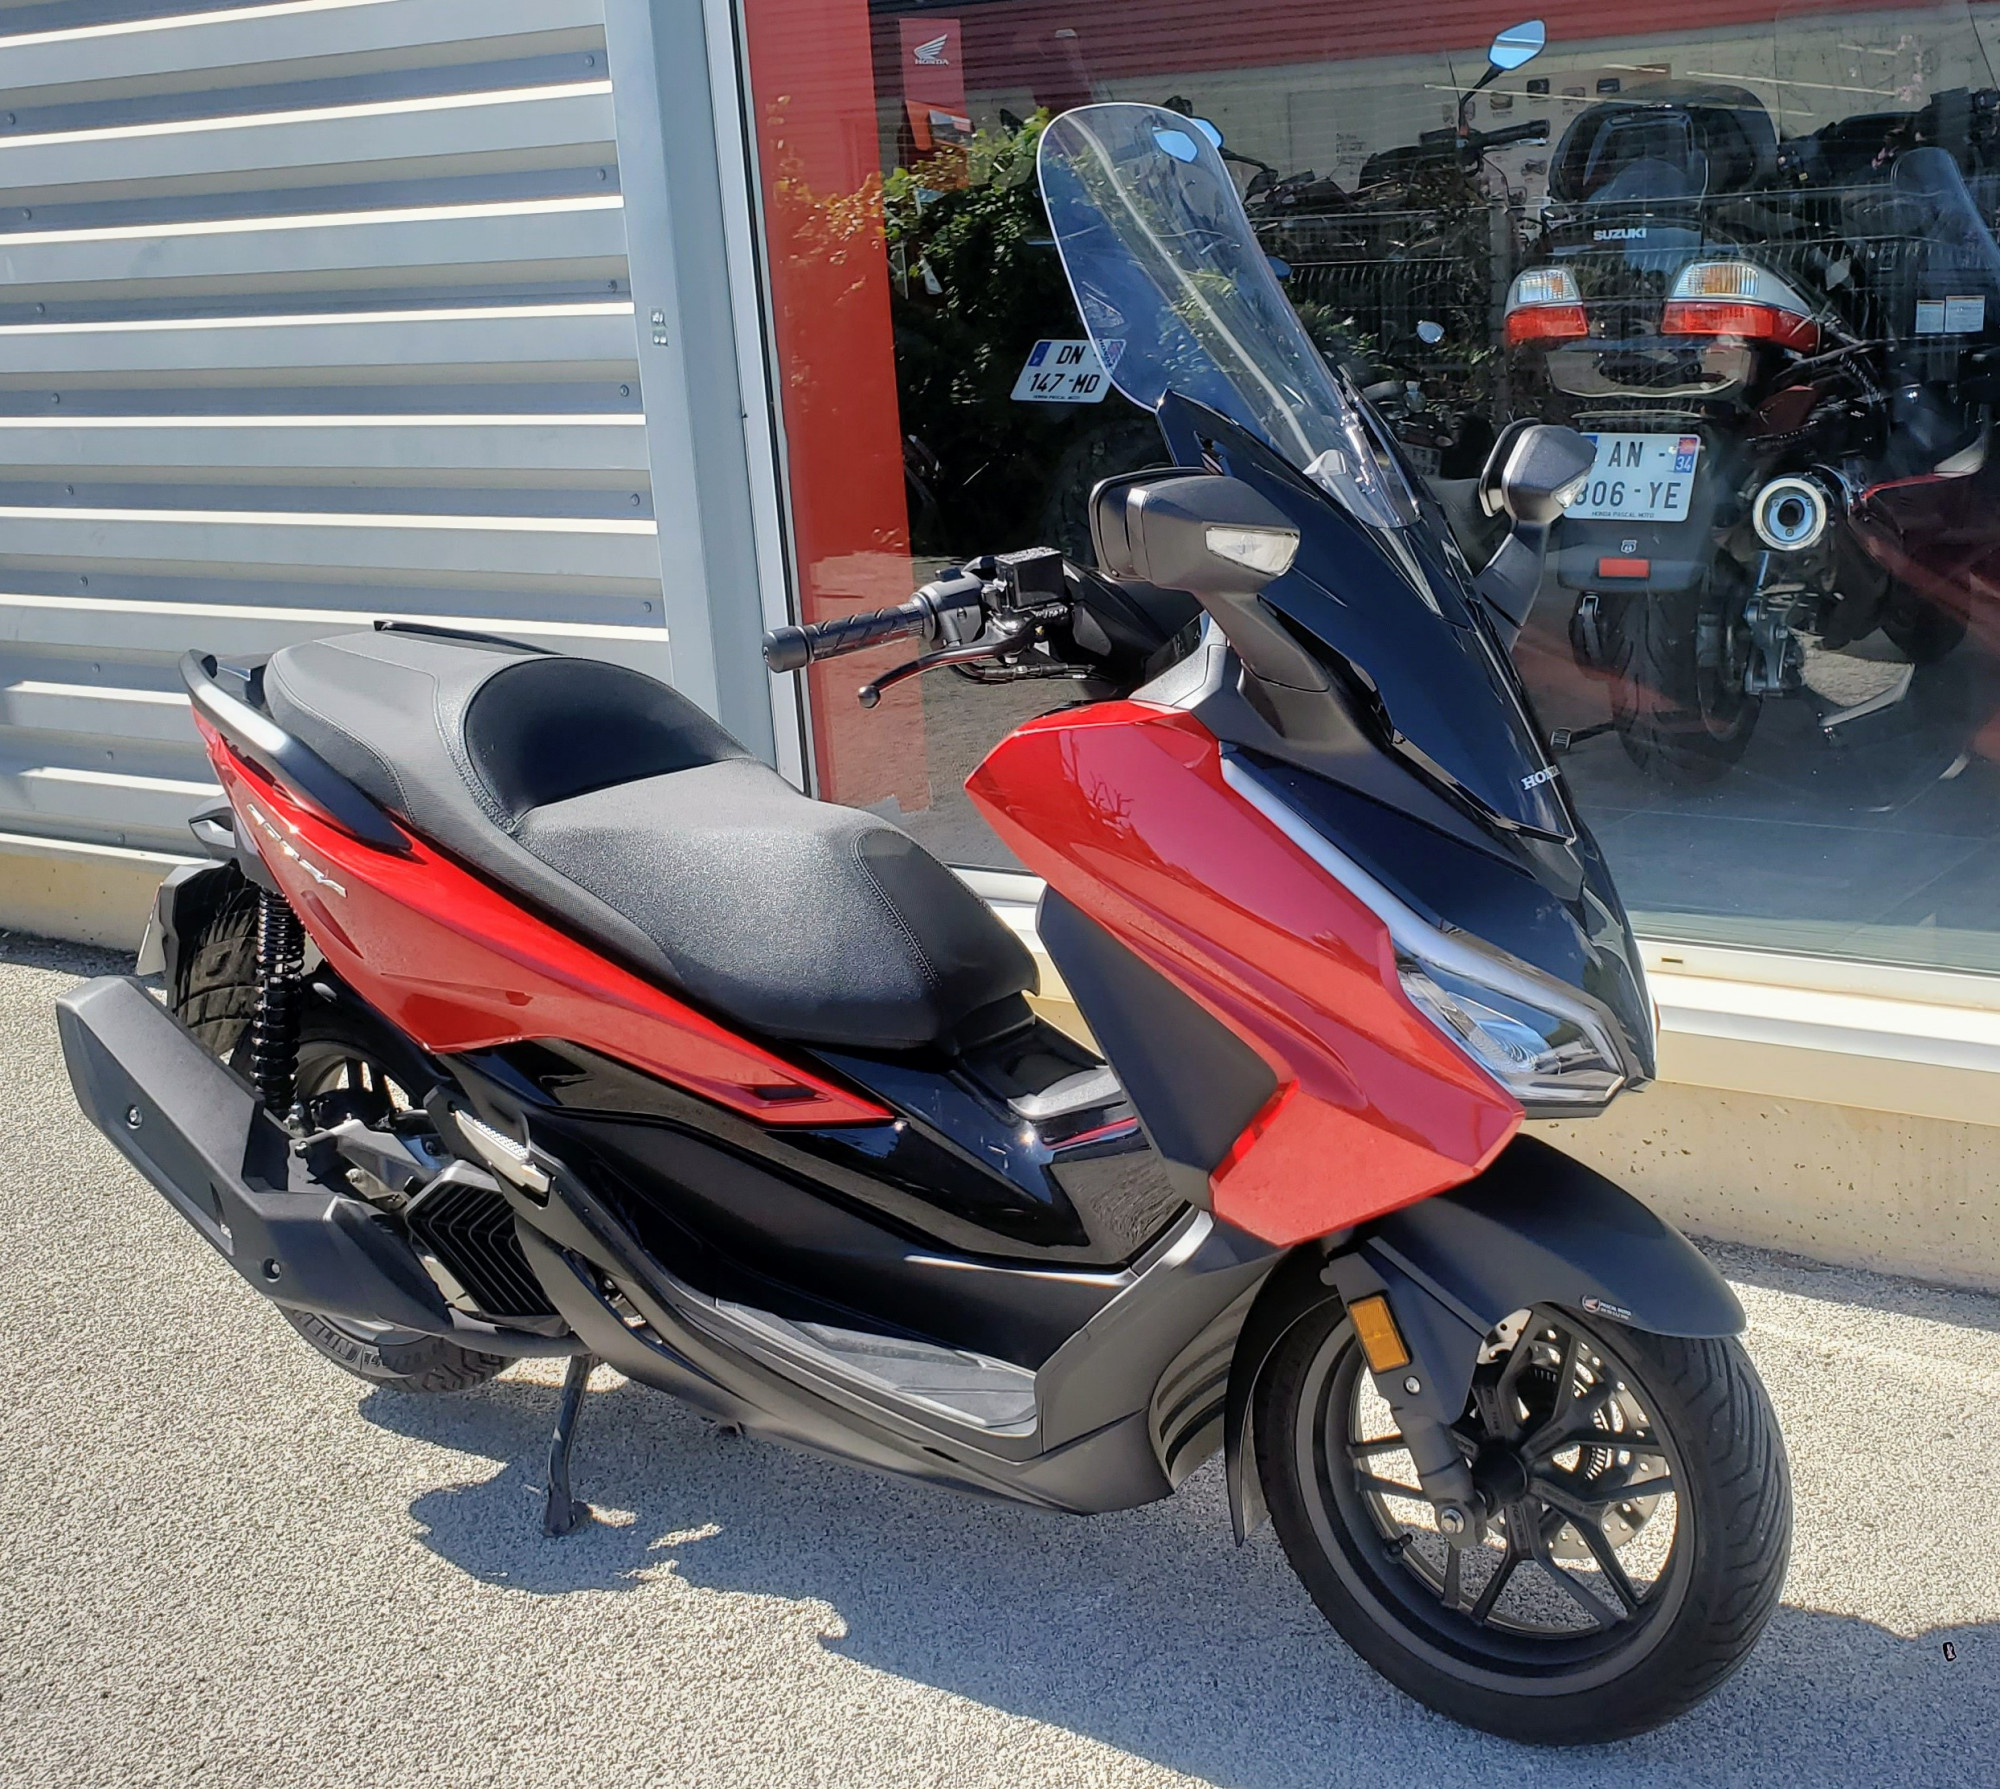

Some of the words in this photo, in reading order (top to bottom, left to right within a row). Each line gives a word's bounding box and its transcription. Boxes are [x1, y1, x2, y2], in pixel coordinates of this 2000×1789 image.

[1593, 228, 1647, 241] SUZUKI
[1056, 345, 1086, 365] DN
[1675, 455, 1692, 471] 34
